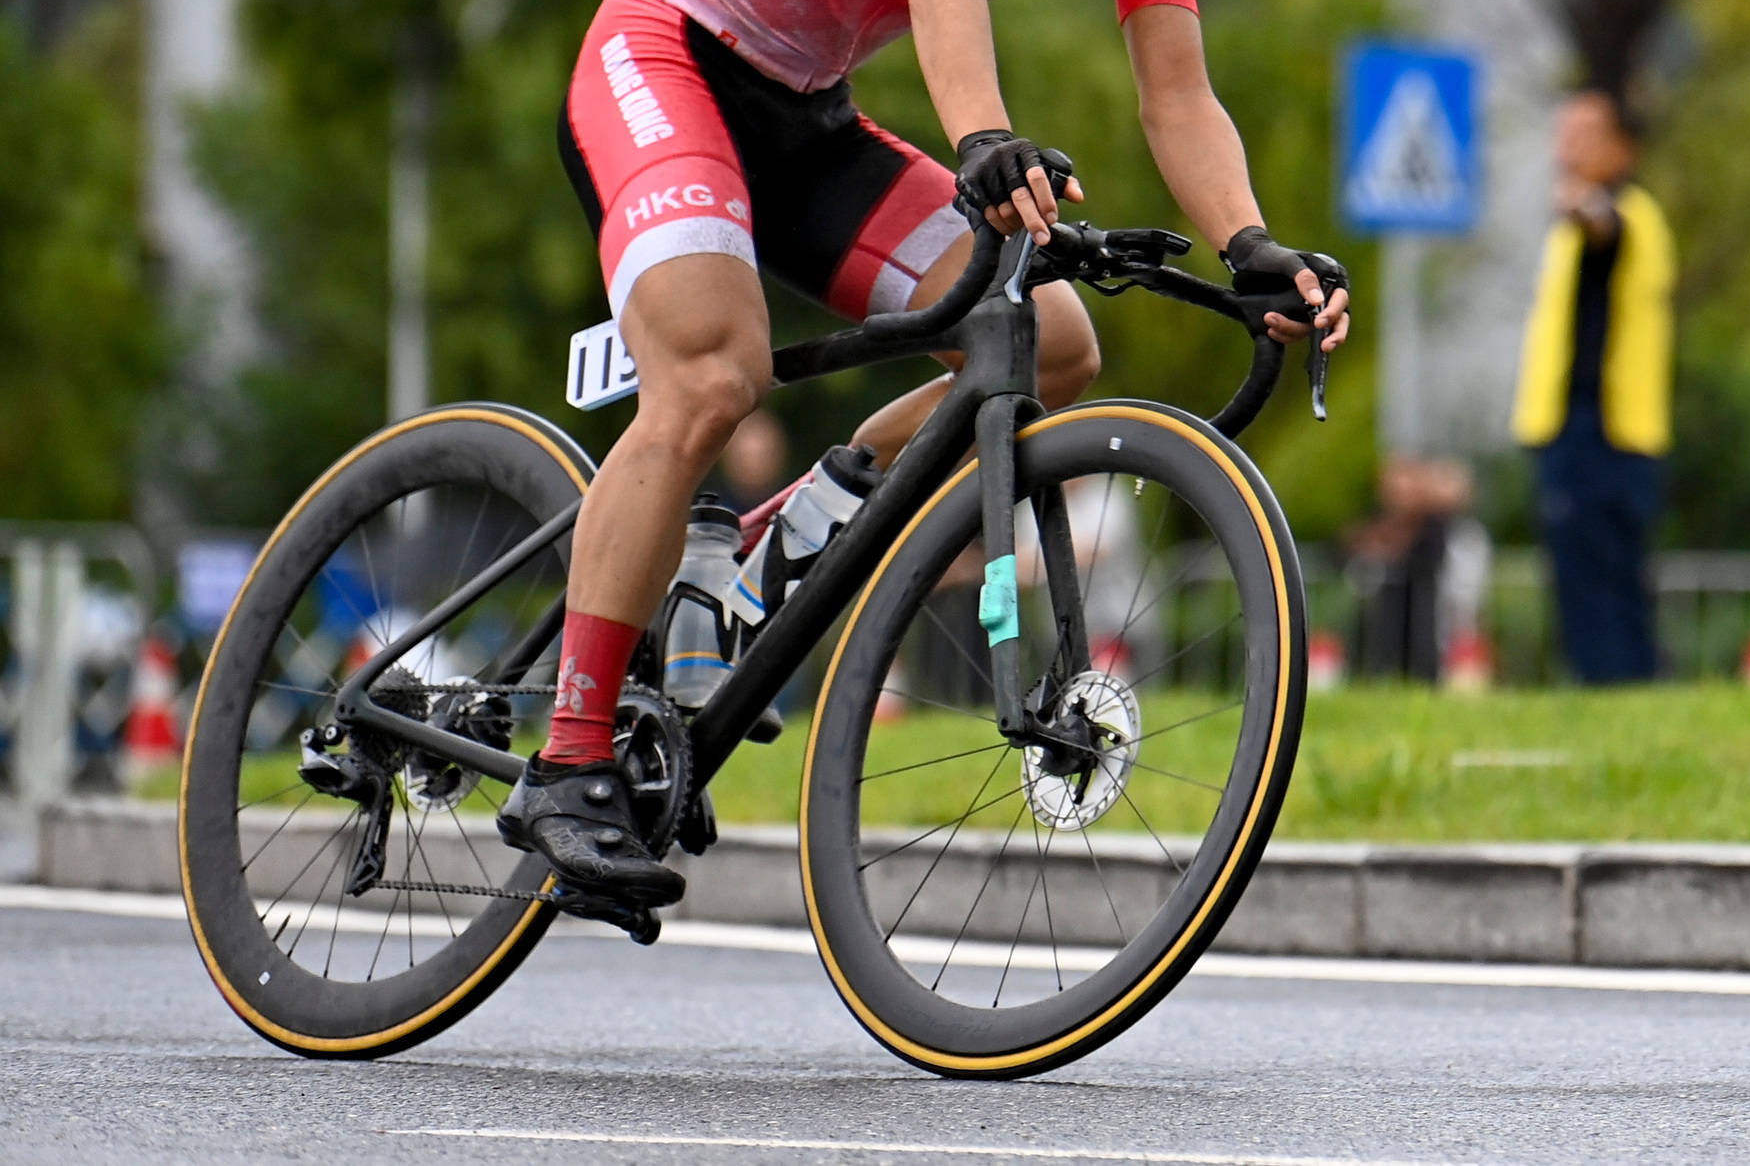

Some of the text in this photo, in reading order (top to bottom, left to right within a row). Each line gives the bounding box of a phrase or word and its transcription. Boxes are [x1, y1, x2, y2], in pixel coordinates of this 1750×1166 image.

[600, 32, 675, 149] HONG KONG
[624, 184, 715, 230] HKG
